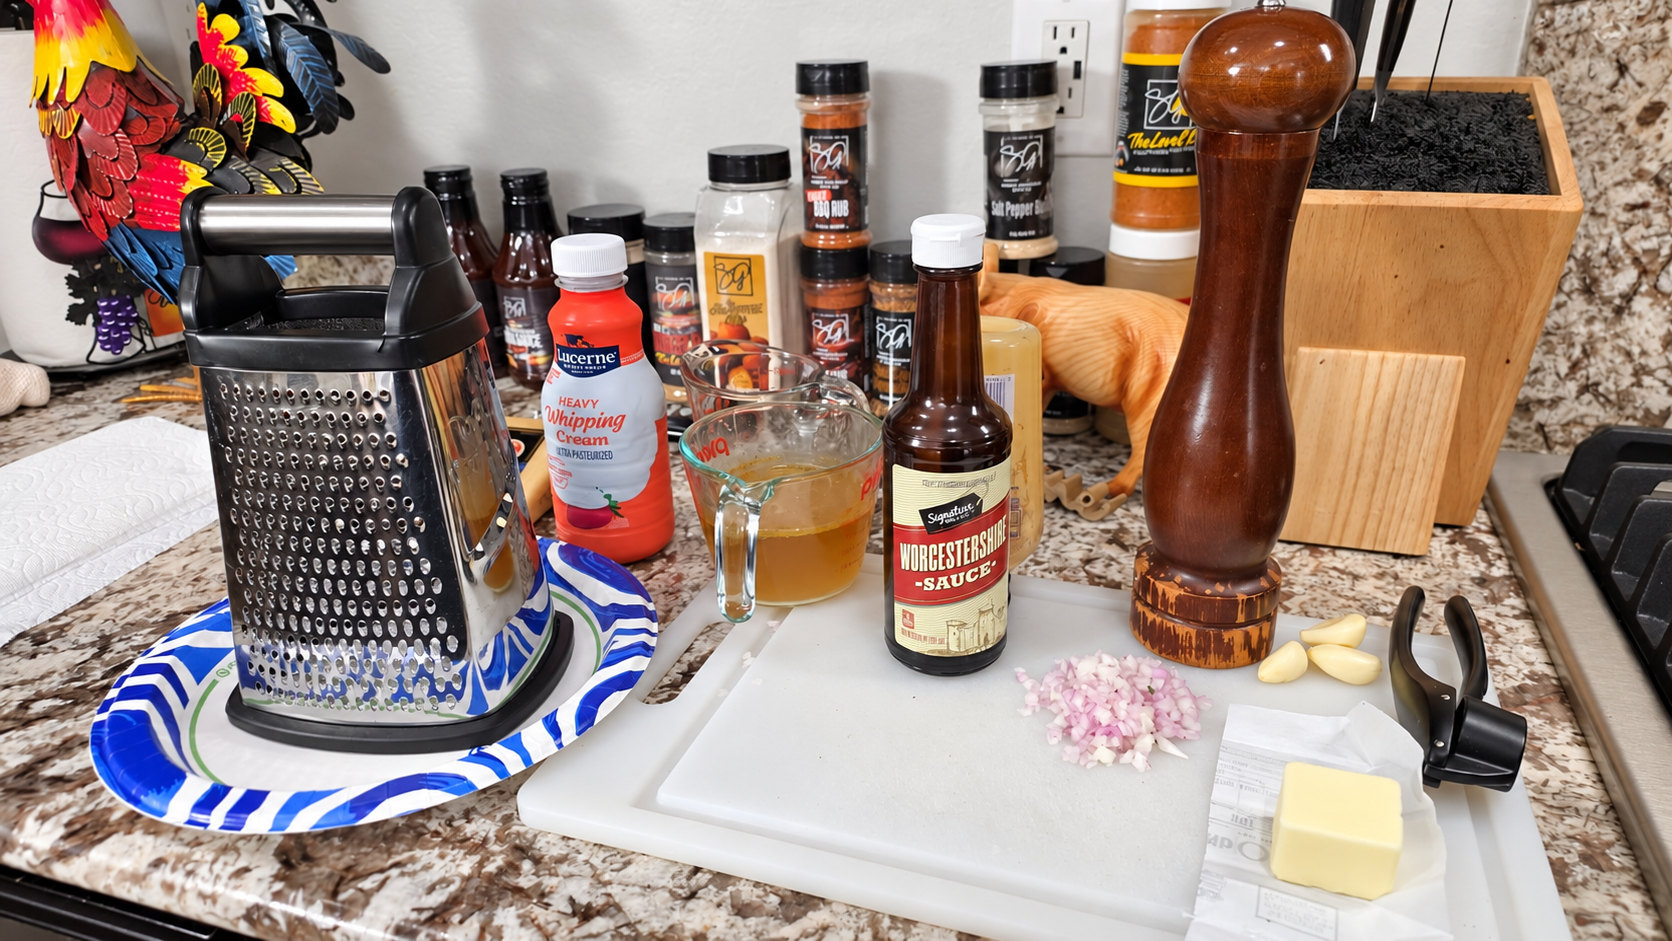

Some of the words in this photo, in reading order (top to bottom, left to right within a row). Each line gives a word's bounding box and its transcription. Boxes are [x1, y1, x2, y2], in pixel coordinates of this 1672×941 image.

[1127, 132, 1150, 149] The
[991, 200, 1004, 217] Salt
[1005, 201, 1034, 219] Pepper
[557, 348, 616, 365] Lucerne
[558, 396, 599, 409] HEAVY
[545, 405, 626, 433] Whipping
[556, 430, 609, 446] Cream
[927, 502, 975, 525] Signature
[899, 514, 1007, 572] WORCESTERSHIRE
